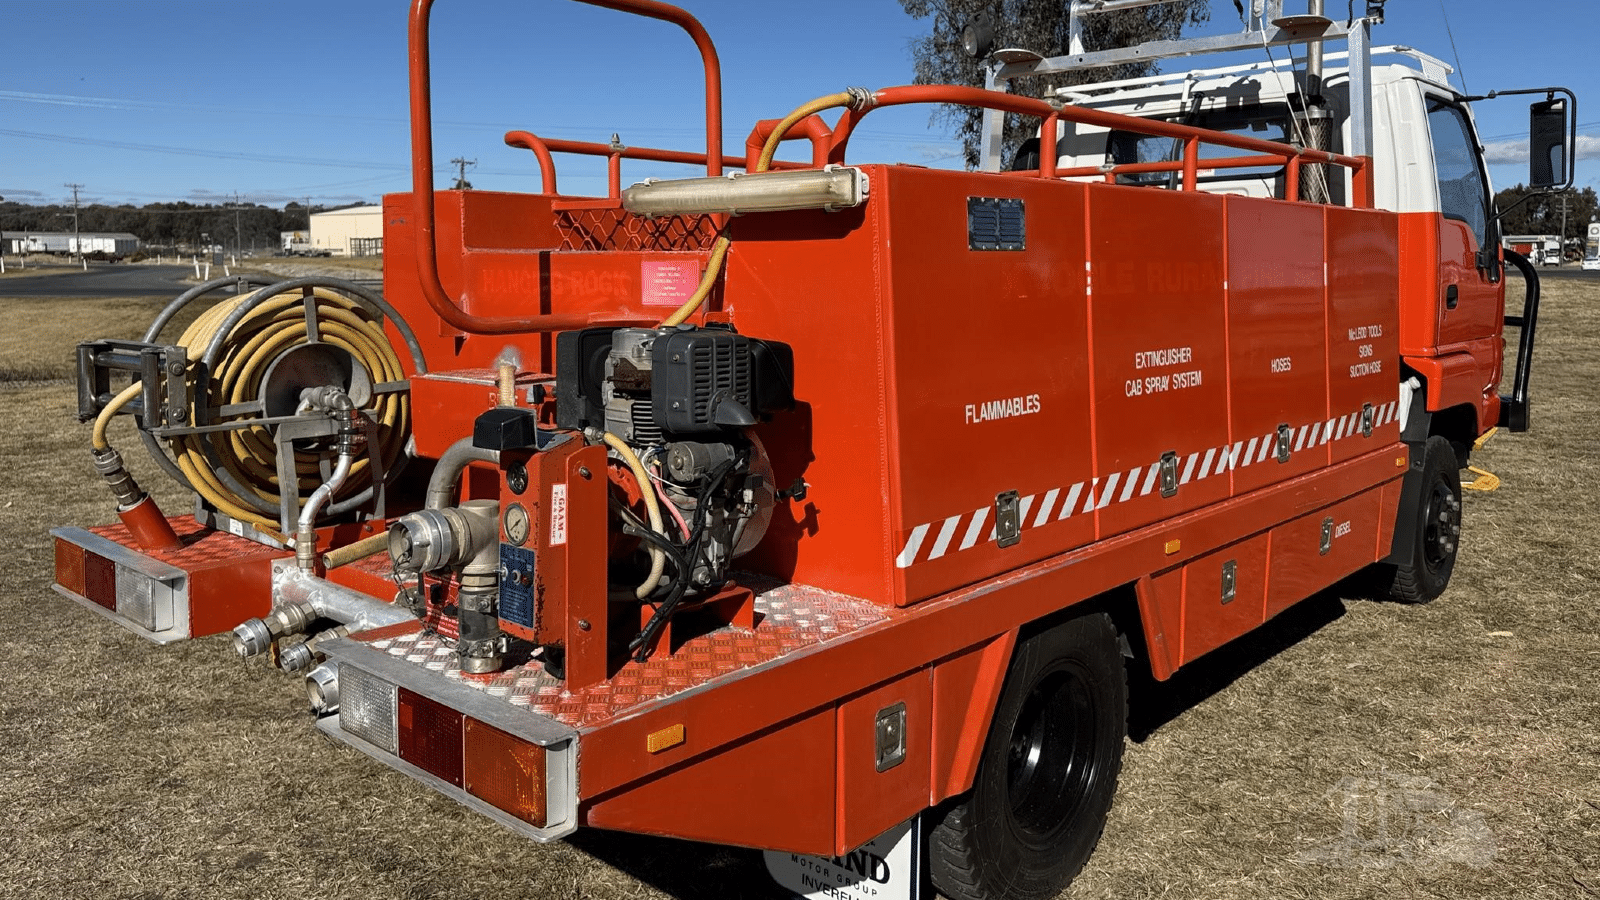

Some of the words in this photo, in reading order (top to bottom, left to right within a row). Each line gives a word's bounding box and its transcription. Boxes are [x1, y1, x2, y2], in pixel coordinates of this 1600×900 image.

[1368, 324, 1382, 338] TOOLS
[1135, 347, 1192, 369] EXTINGUISHER
[1359, 344, 1373, 358] SIGNS
[1271, 357, 1292, 373] HOSES
[1350, 363, 1370, 378] SUCTION
[1369, 360, 1382, 374] HOSE
[1125, 379, 1143, 397] CAB
[1145, 374, 1170, 395] SPRAY
[1172, 370, 1202, 390] SYSTEM
[965, 393, 1041, 425] FLAMMABLES
[1334, 520, 1351, 538] DIESEL
[791, 853, 830, 878] MOTOR
[836, 874, 878, 896] GROUP
